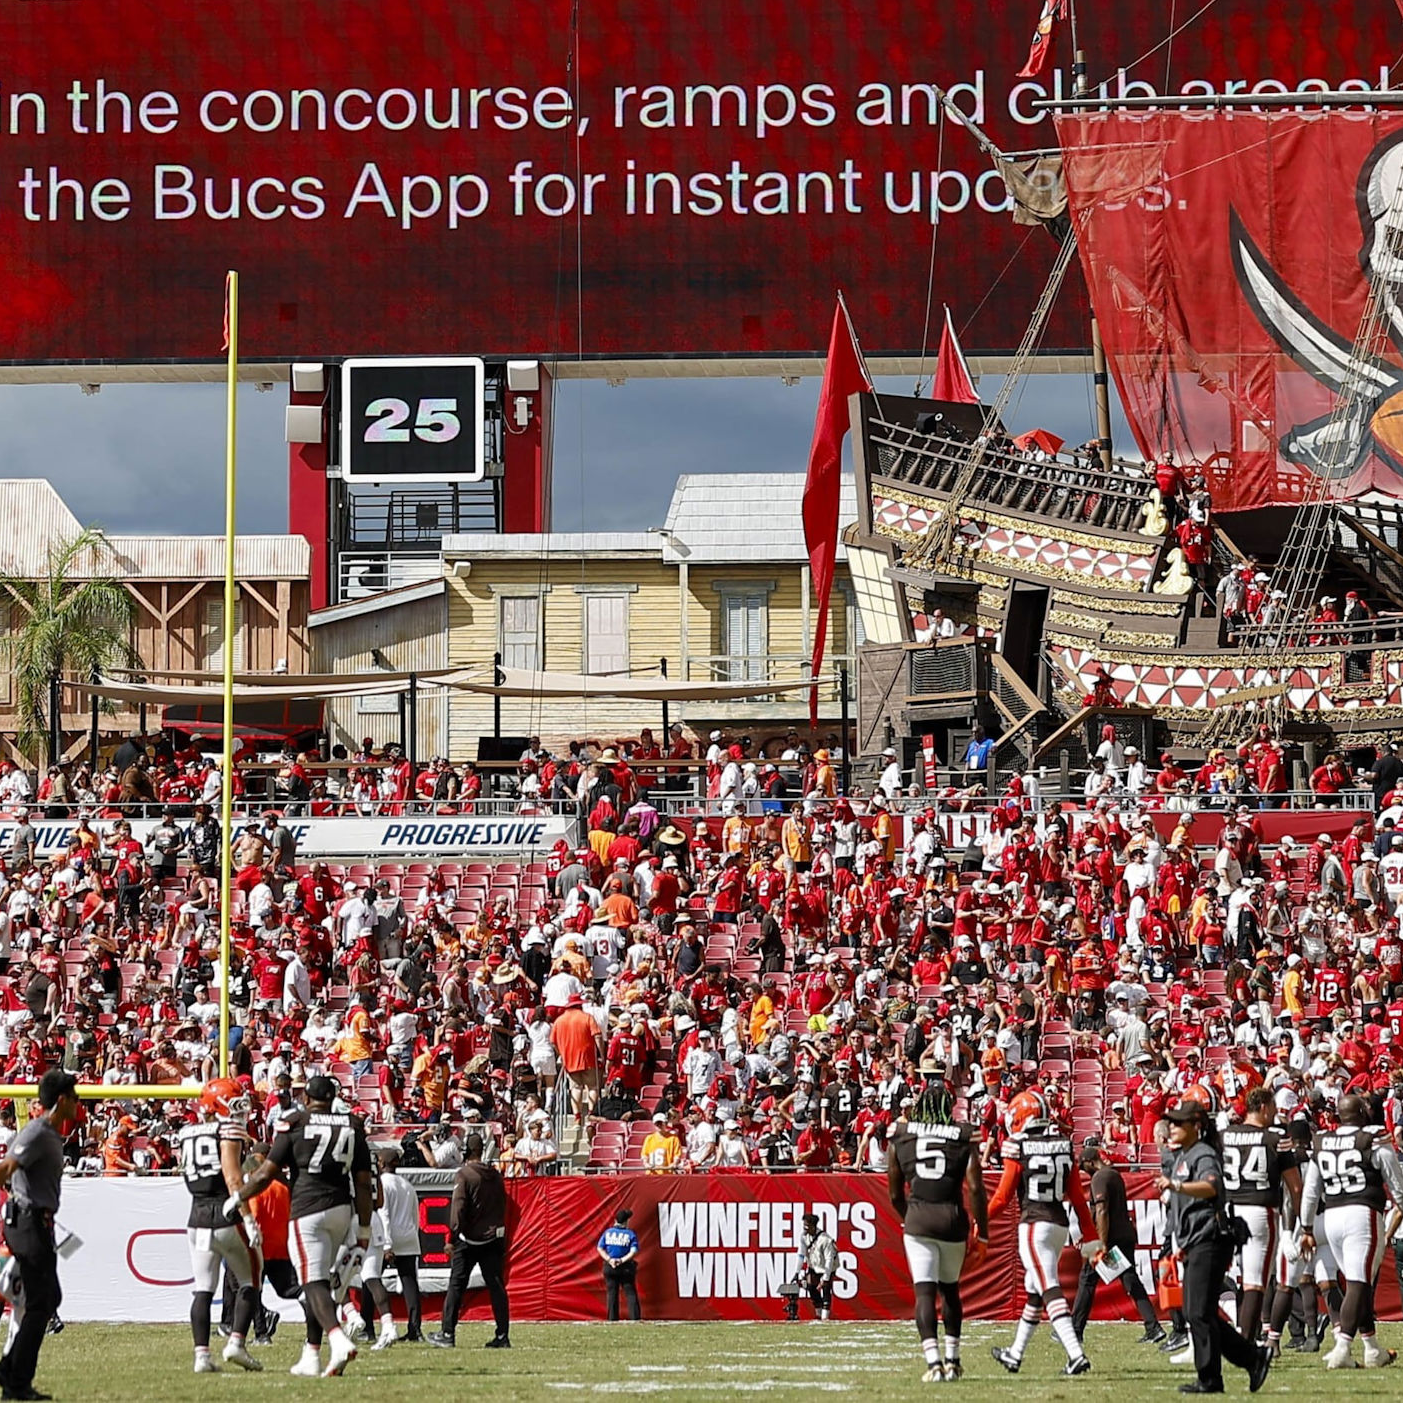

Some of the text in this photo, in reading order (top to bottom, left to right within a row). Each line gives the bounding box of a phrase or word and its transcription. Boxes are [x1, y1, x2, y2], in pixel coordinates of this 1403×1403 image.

[67, 78, 180, 135] the
[199, 85, 589, 138] concourse,
[614, 82, 835, 138] ramps
[855, 69, 986, 126] and
[19, 166, 131, 221] the
[154, 164, 326, 222] Bucs
[343, 162, 490, 229] App
[508, 160, 607, 217] for
[624, 158, 862, 216] instant
[364, 397, 461, 444] 25
[380, 822, 547, 847] PROGRESSIVE
[314, 887, 323, 901] 6
[759, 880, 769, 896] 2
[1153, 925, 1162, 941] 3
[1319, 982, 1338, 1001] 12
[952, 1014, 972, 1036] 24
[1392, 1018, 1400, 1035] 6
[622, 1048, 635, 1065] 31
[700, 1065, 708, 1078] 7
[838, 1091, 852, 1112] 2
[309, 1112, 350, 1127] JENKINS
[907, 1122, 960, 1140] WILLIAMS
[1223, 1131, 1264, 1146] GRAHAM
[304, 1124, 355, 1173] 74
[1321, 1135, 1355, 1150] COLLINS
[915, 1137, 947, 1180] 5
[1027, 1155, 1074, 1203] 20
[1316, 1148, 1366, 1196] 96
